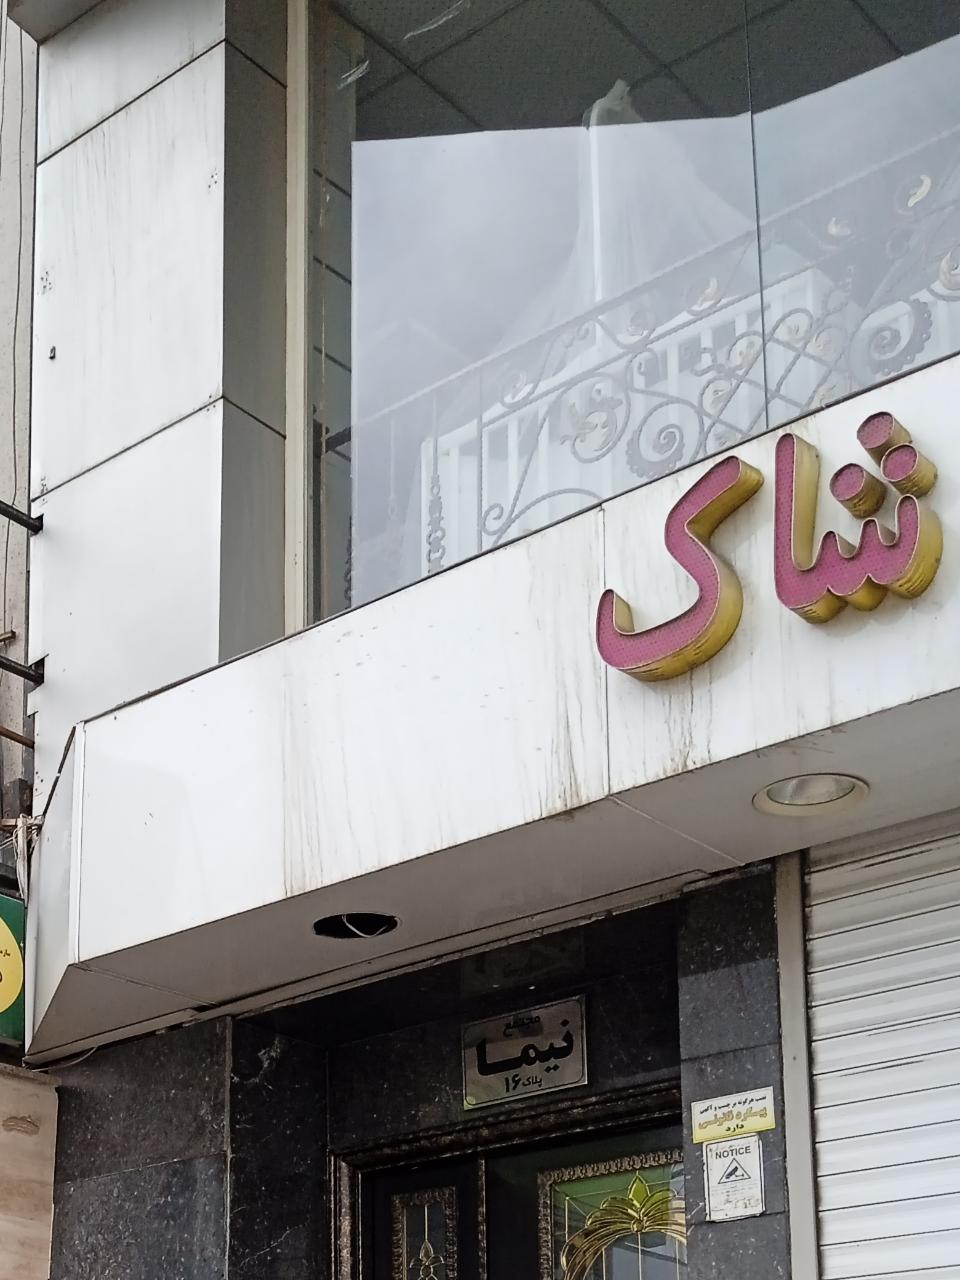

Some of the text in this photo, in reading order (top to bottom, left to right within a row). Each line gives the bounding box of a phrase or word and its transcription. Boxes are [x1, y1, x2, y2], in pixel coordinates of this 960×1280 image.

[503, 1015, 540, 1037] مجتمع
[477, 1019, 573, 1076] نیما
[505, 1074, 542, 1093] پلاک ۱۶
[725, 1124, 744, 1132] دارد
[715, 1146, 751, 1159] NOTICE
